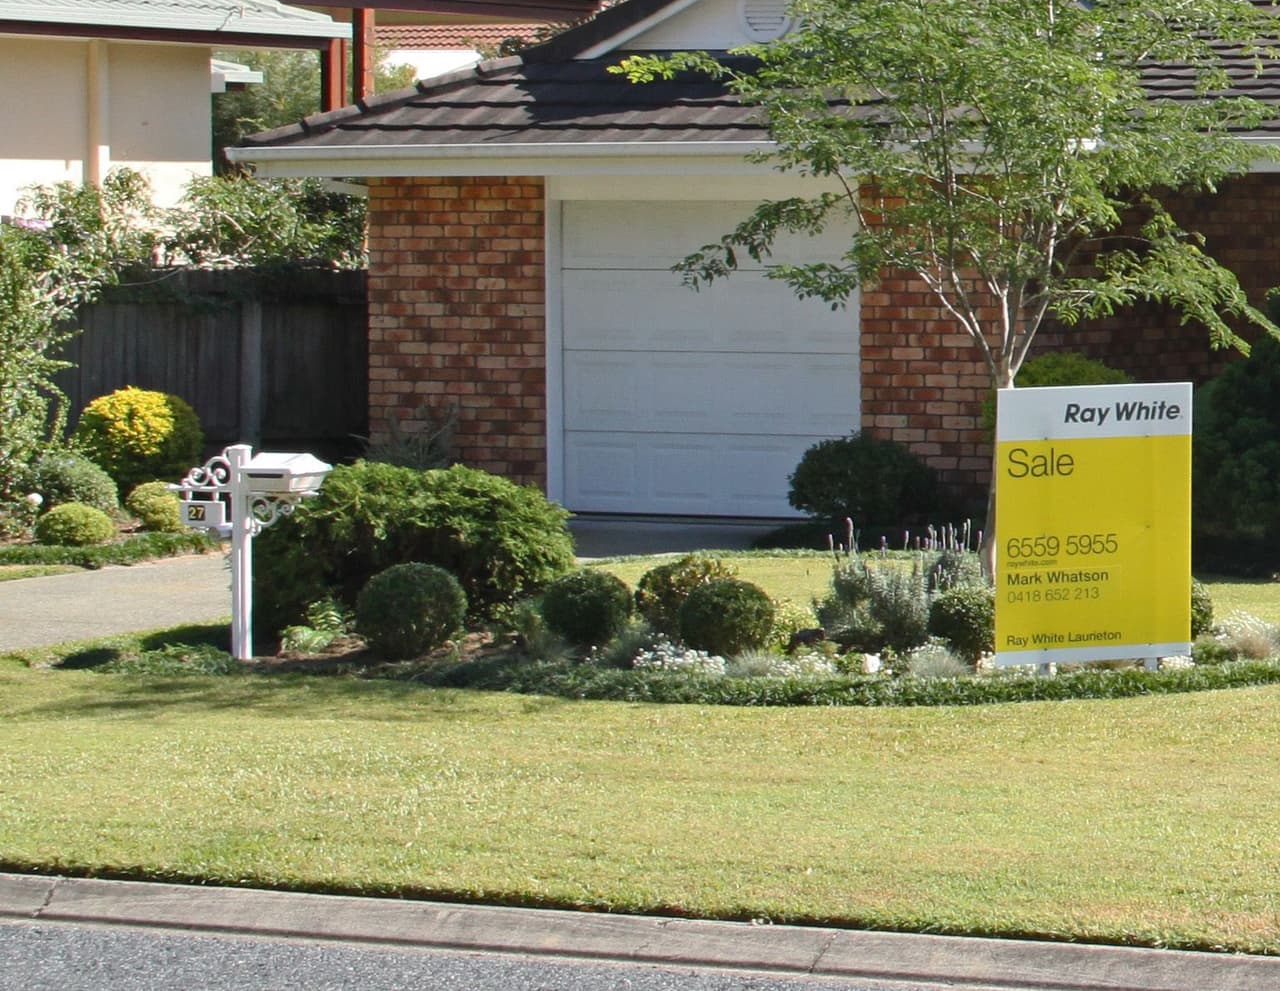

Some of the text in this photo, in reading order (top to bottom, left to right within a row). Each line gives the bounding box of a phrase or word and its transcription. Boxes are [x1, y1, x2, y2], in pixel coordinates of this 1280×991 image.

[1064, 401, 1180, 426] Ray White
[1007, 447, 1075, 478] Sale
[189, 506, 205, 520] 27
[1007, 533, 1118, 558] 6559 5955
[1007, 571, 1109, 585] Mark Whatson
[1007, 586, 1100, 603] 0418 652 213
[1006, 635, 1028, 647] Ray
[1032, 633, 1064, 644] White
